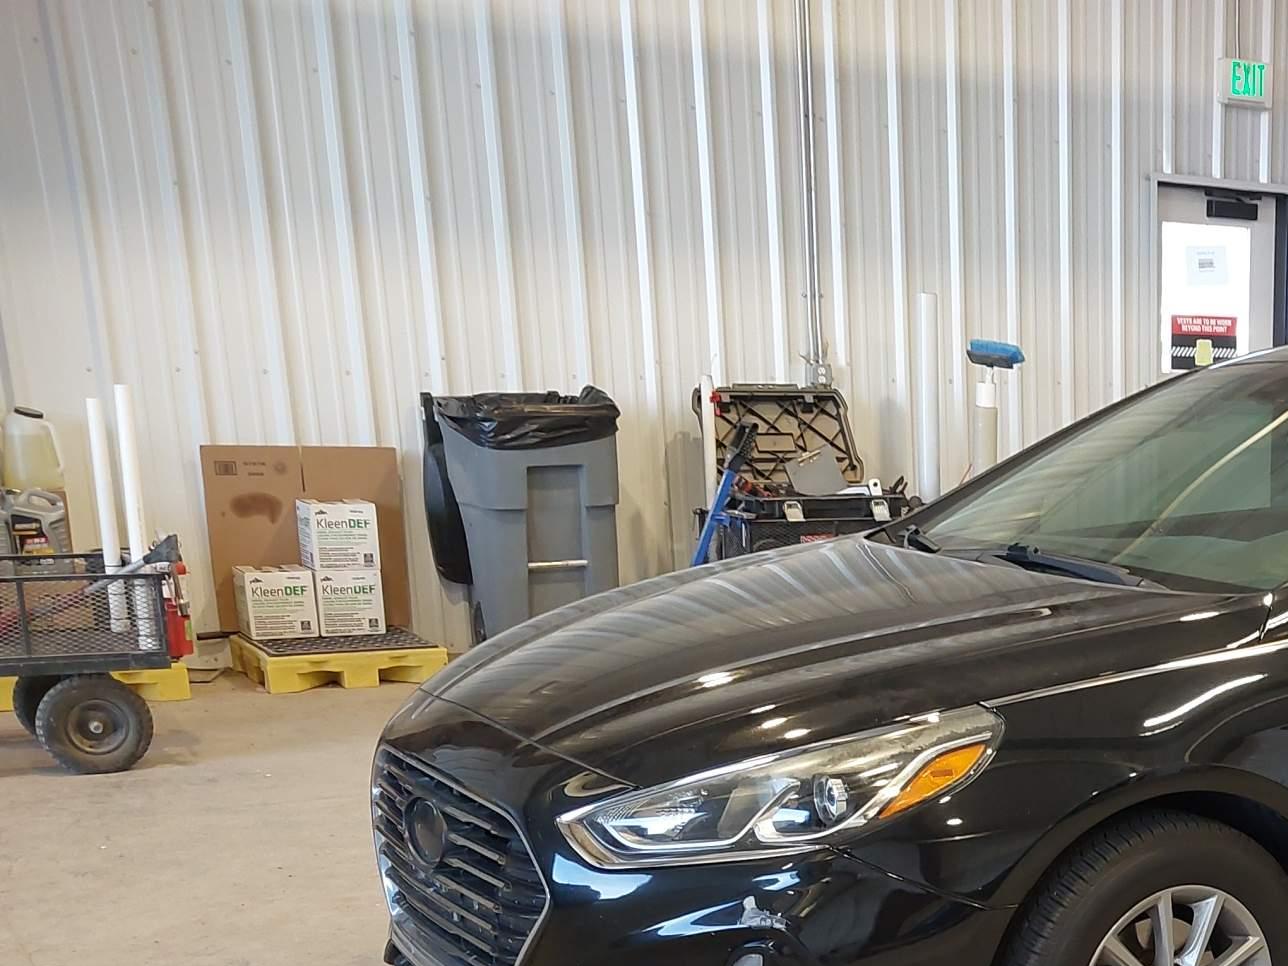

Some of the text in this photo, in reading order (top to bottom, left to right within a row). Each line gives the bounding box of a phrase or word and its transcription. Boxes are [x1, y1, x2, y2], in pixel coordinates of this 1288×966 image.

[1232, 62, 1265, 96] EXIT
[1181, 324, 1201, 332] BEYOND
[1213, 325, 1228, 333] POINT
[316, 517, 372, 529] KleenDEF
[251, 585, 309, 598] KleenDEF
[322, 584, 376, 596] KleenDEF
